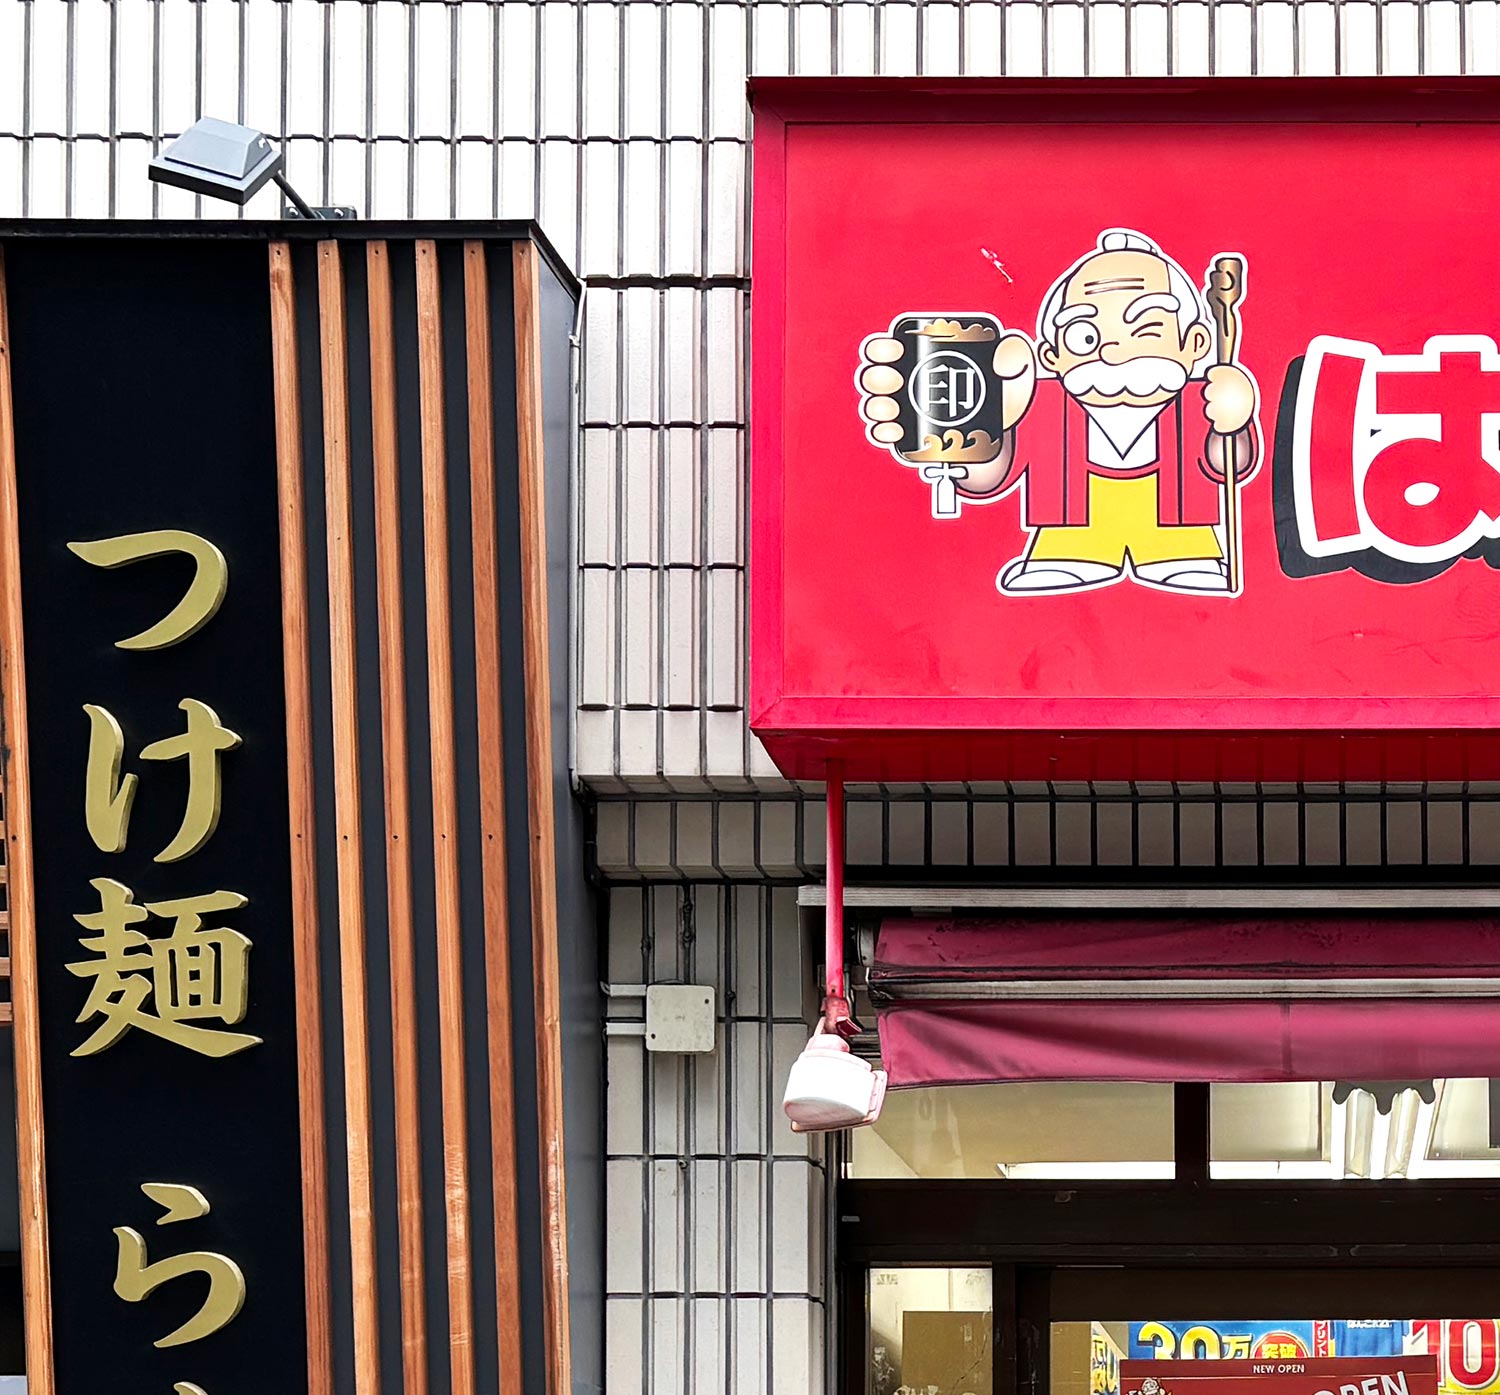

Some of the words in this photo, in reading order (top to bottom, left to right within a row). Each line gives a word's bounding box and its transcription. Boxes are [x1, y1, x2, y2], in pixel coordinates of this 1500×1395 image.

[922, 362, 977, 418] 印
[65, 529, 264, 1058] つけ麺
[1253, 1364, 1275, 1374] NEW
[1278, 1364, 1305, 1374] OPEN
